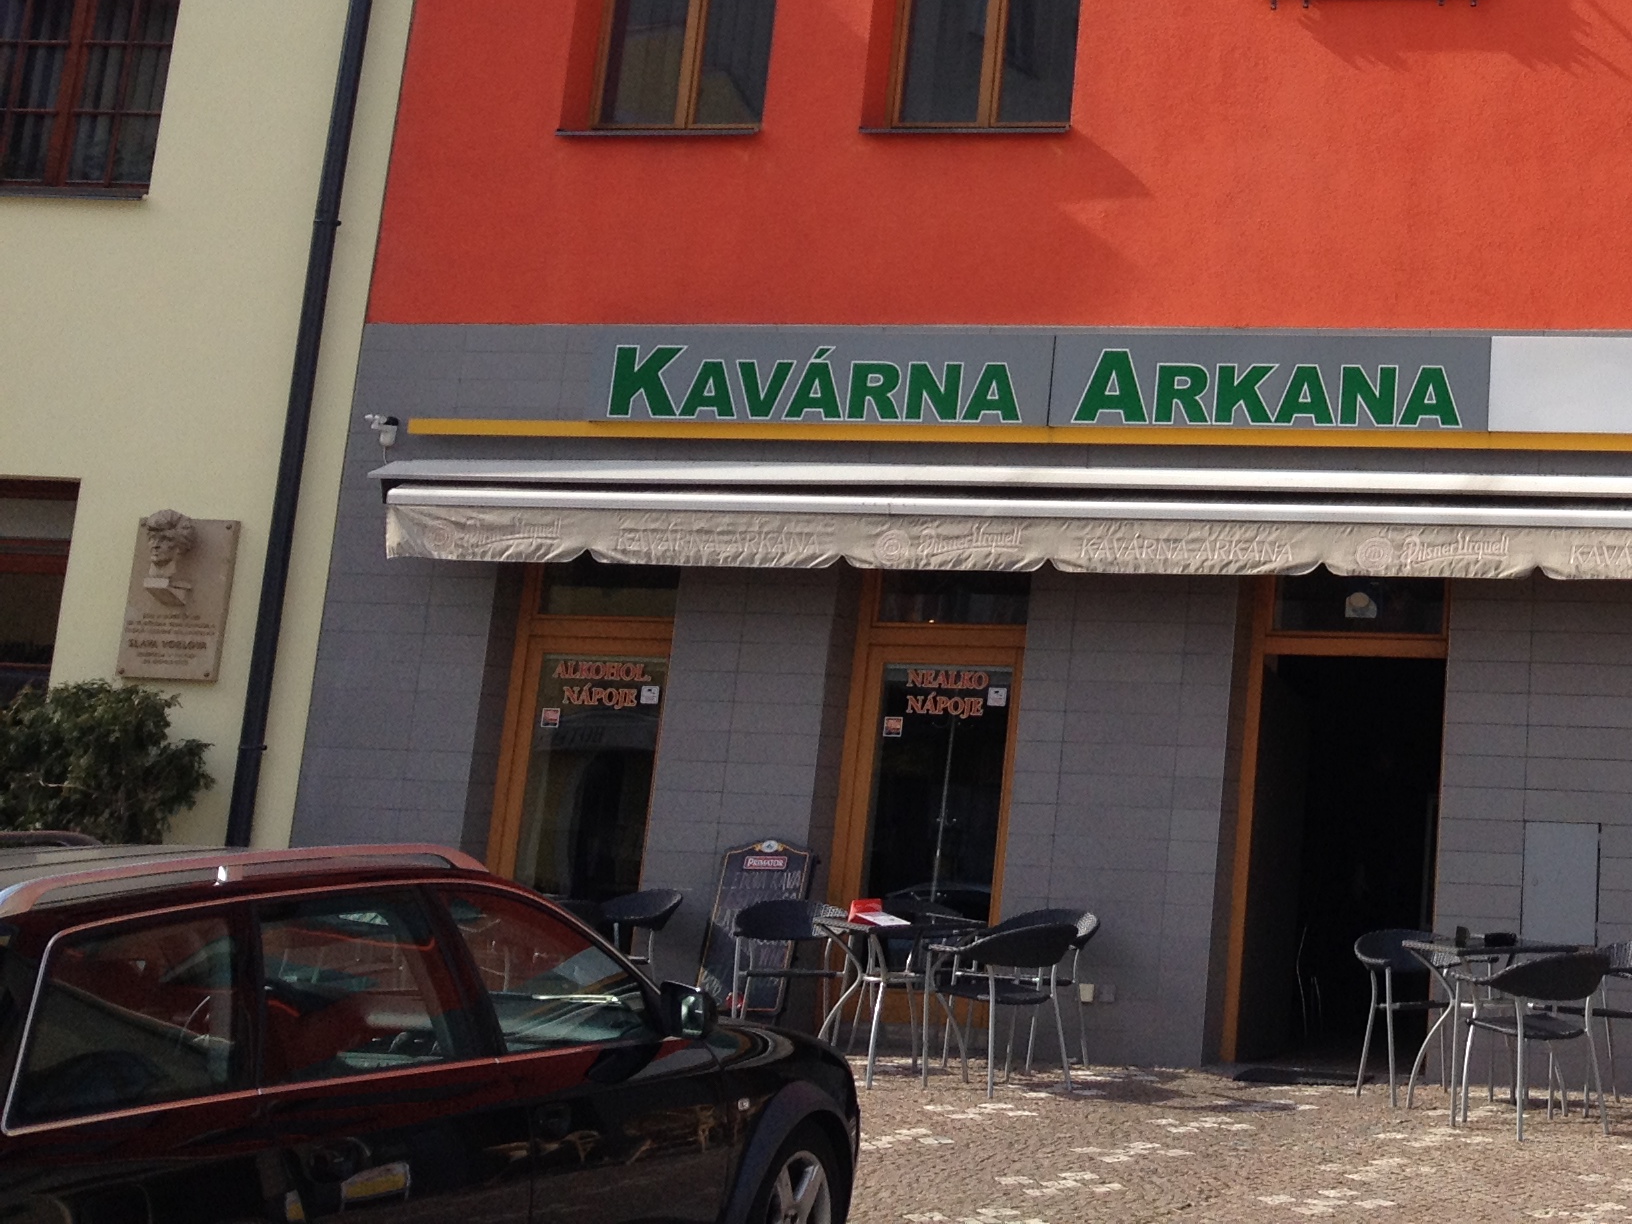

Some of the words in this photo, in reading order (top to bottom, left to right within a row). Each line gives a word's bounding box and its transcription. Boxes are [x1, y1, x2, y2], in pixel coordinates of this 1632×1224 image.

[607, 345, 1022, 423] KAVÁRNA
[1071, 348, 1462, 428] ARKANA
[1081, 532, 1188, 559] KAVÁRNA
[1400, 534, 1457, 568] Pilsner
[1456, 531, 1509, 560] Urquell
[906, 669, 989, 690] NEALKO
[562, 682, 638, 710] NÁPOJE
[906, 691, 984, 719] NÁPOJE
